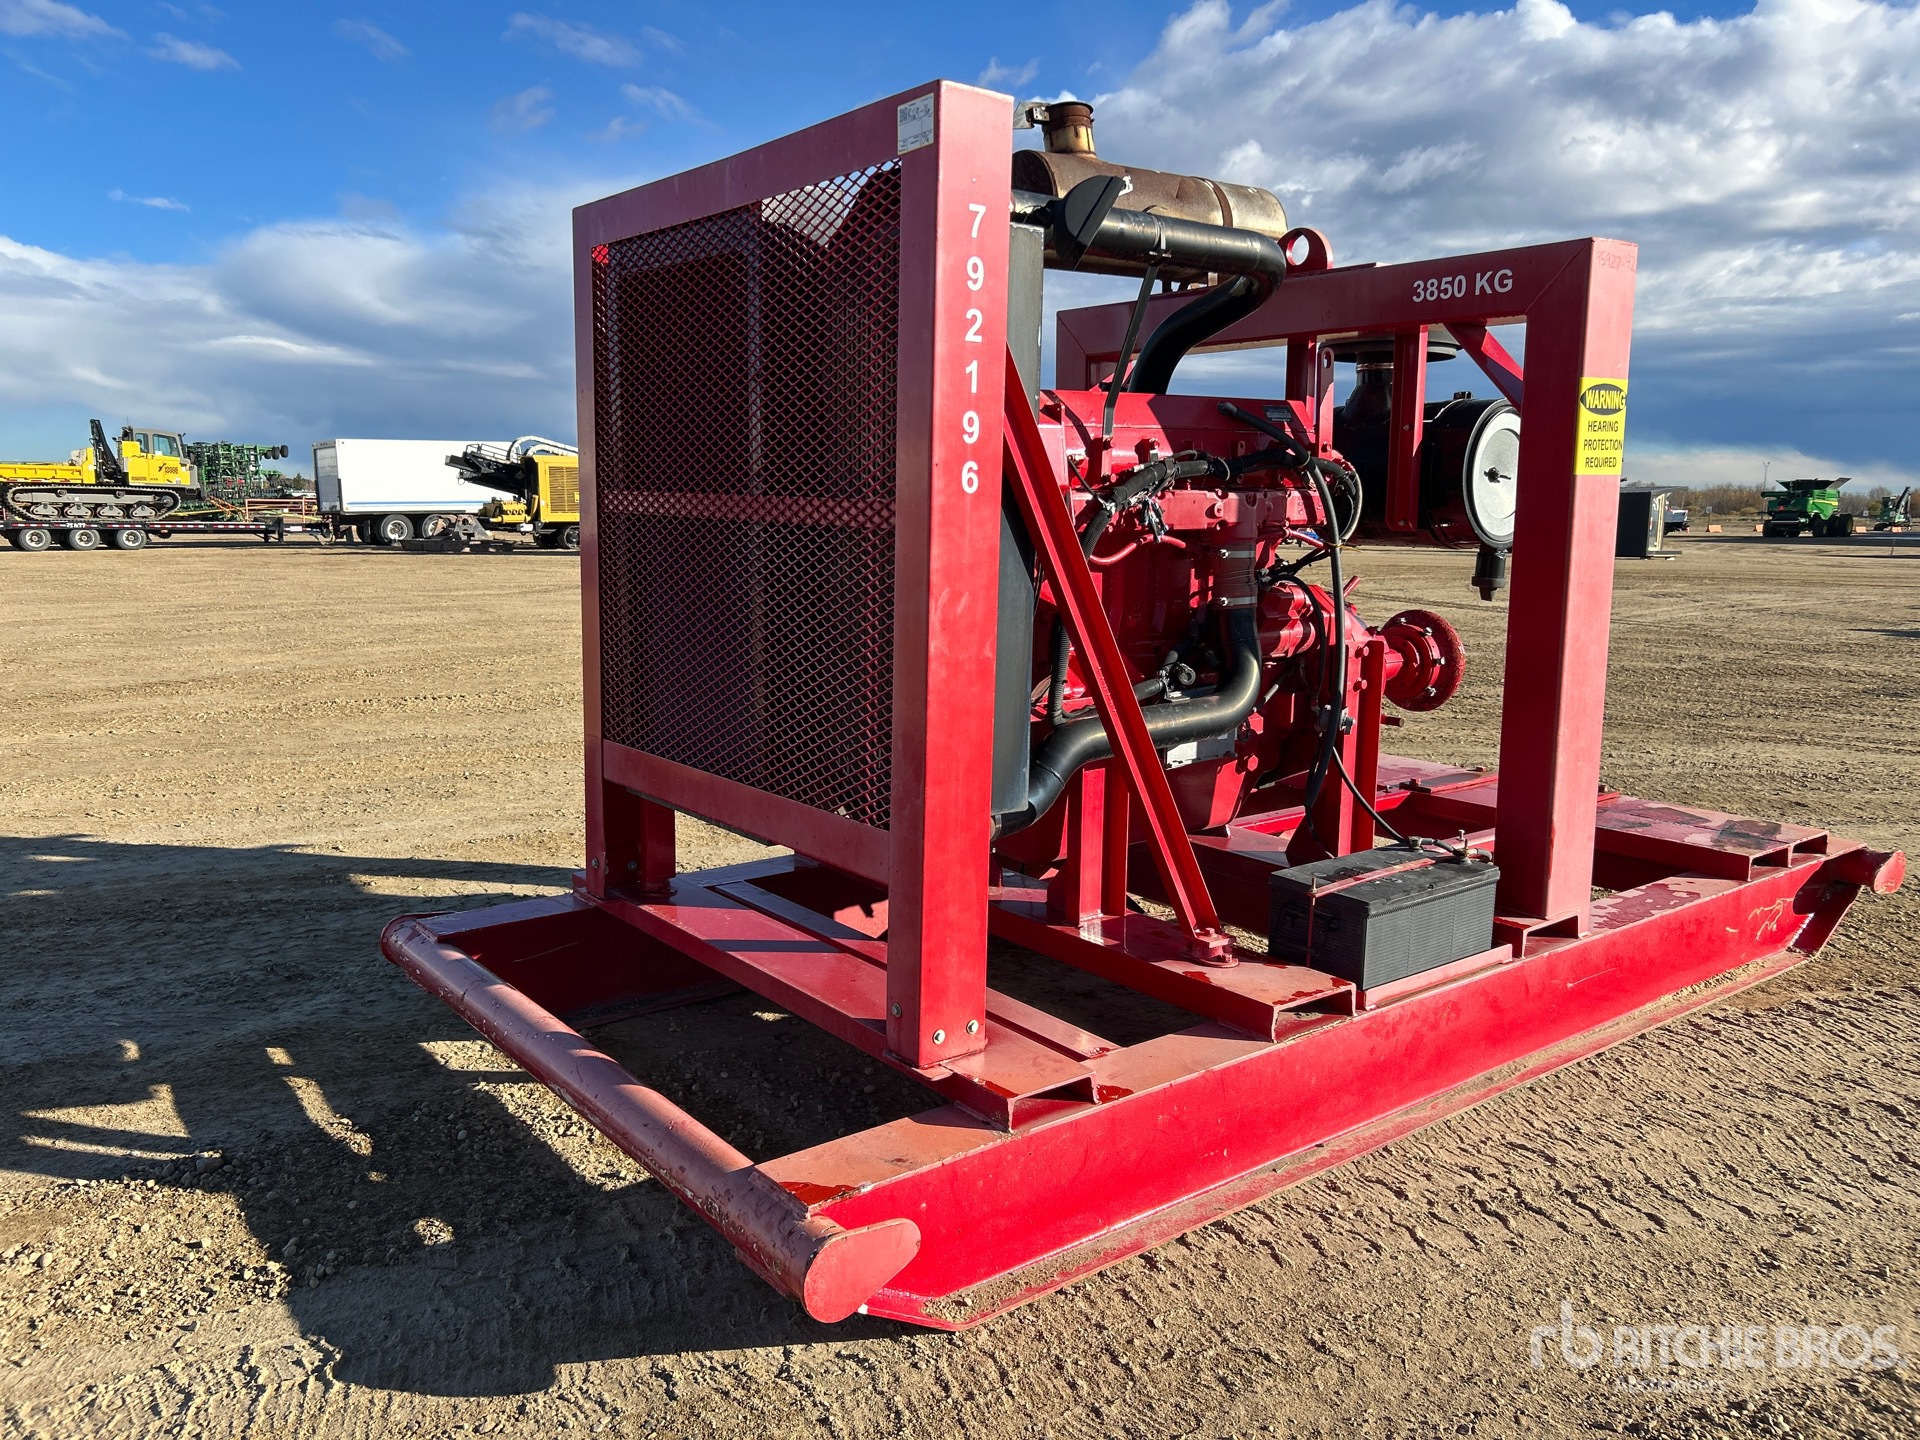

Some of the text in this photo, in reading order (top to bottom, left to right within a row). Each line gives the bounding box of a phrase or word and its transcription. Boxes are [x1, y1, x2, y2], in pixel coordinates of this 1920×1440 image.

[1412, 268, 1513, 303] 3850 KG
[1583, 388, 1627, 410] WARNING
[1587, 420, 1619, 433] HEARING
[1583, 438, 1623, 452] PROTECTION
[1585, 456, 1617, 468] REQUIRED
